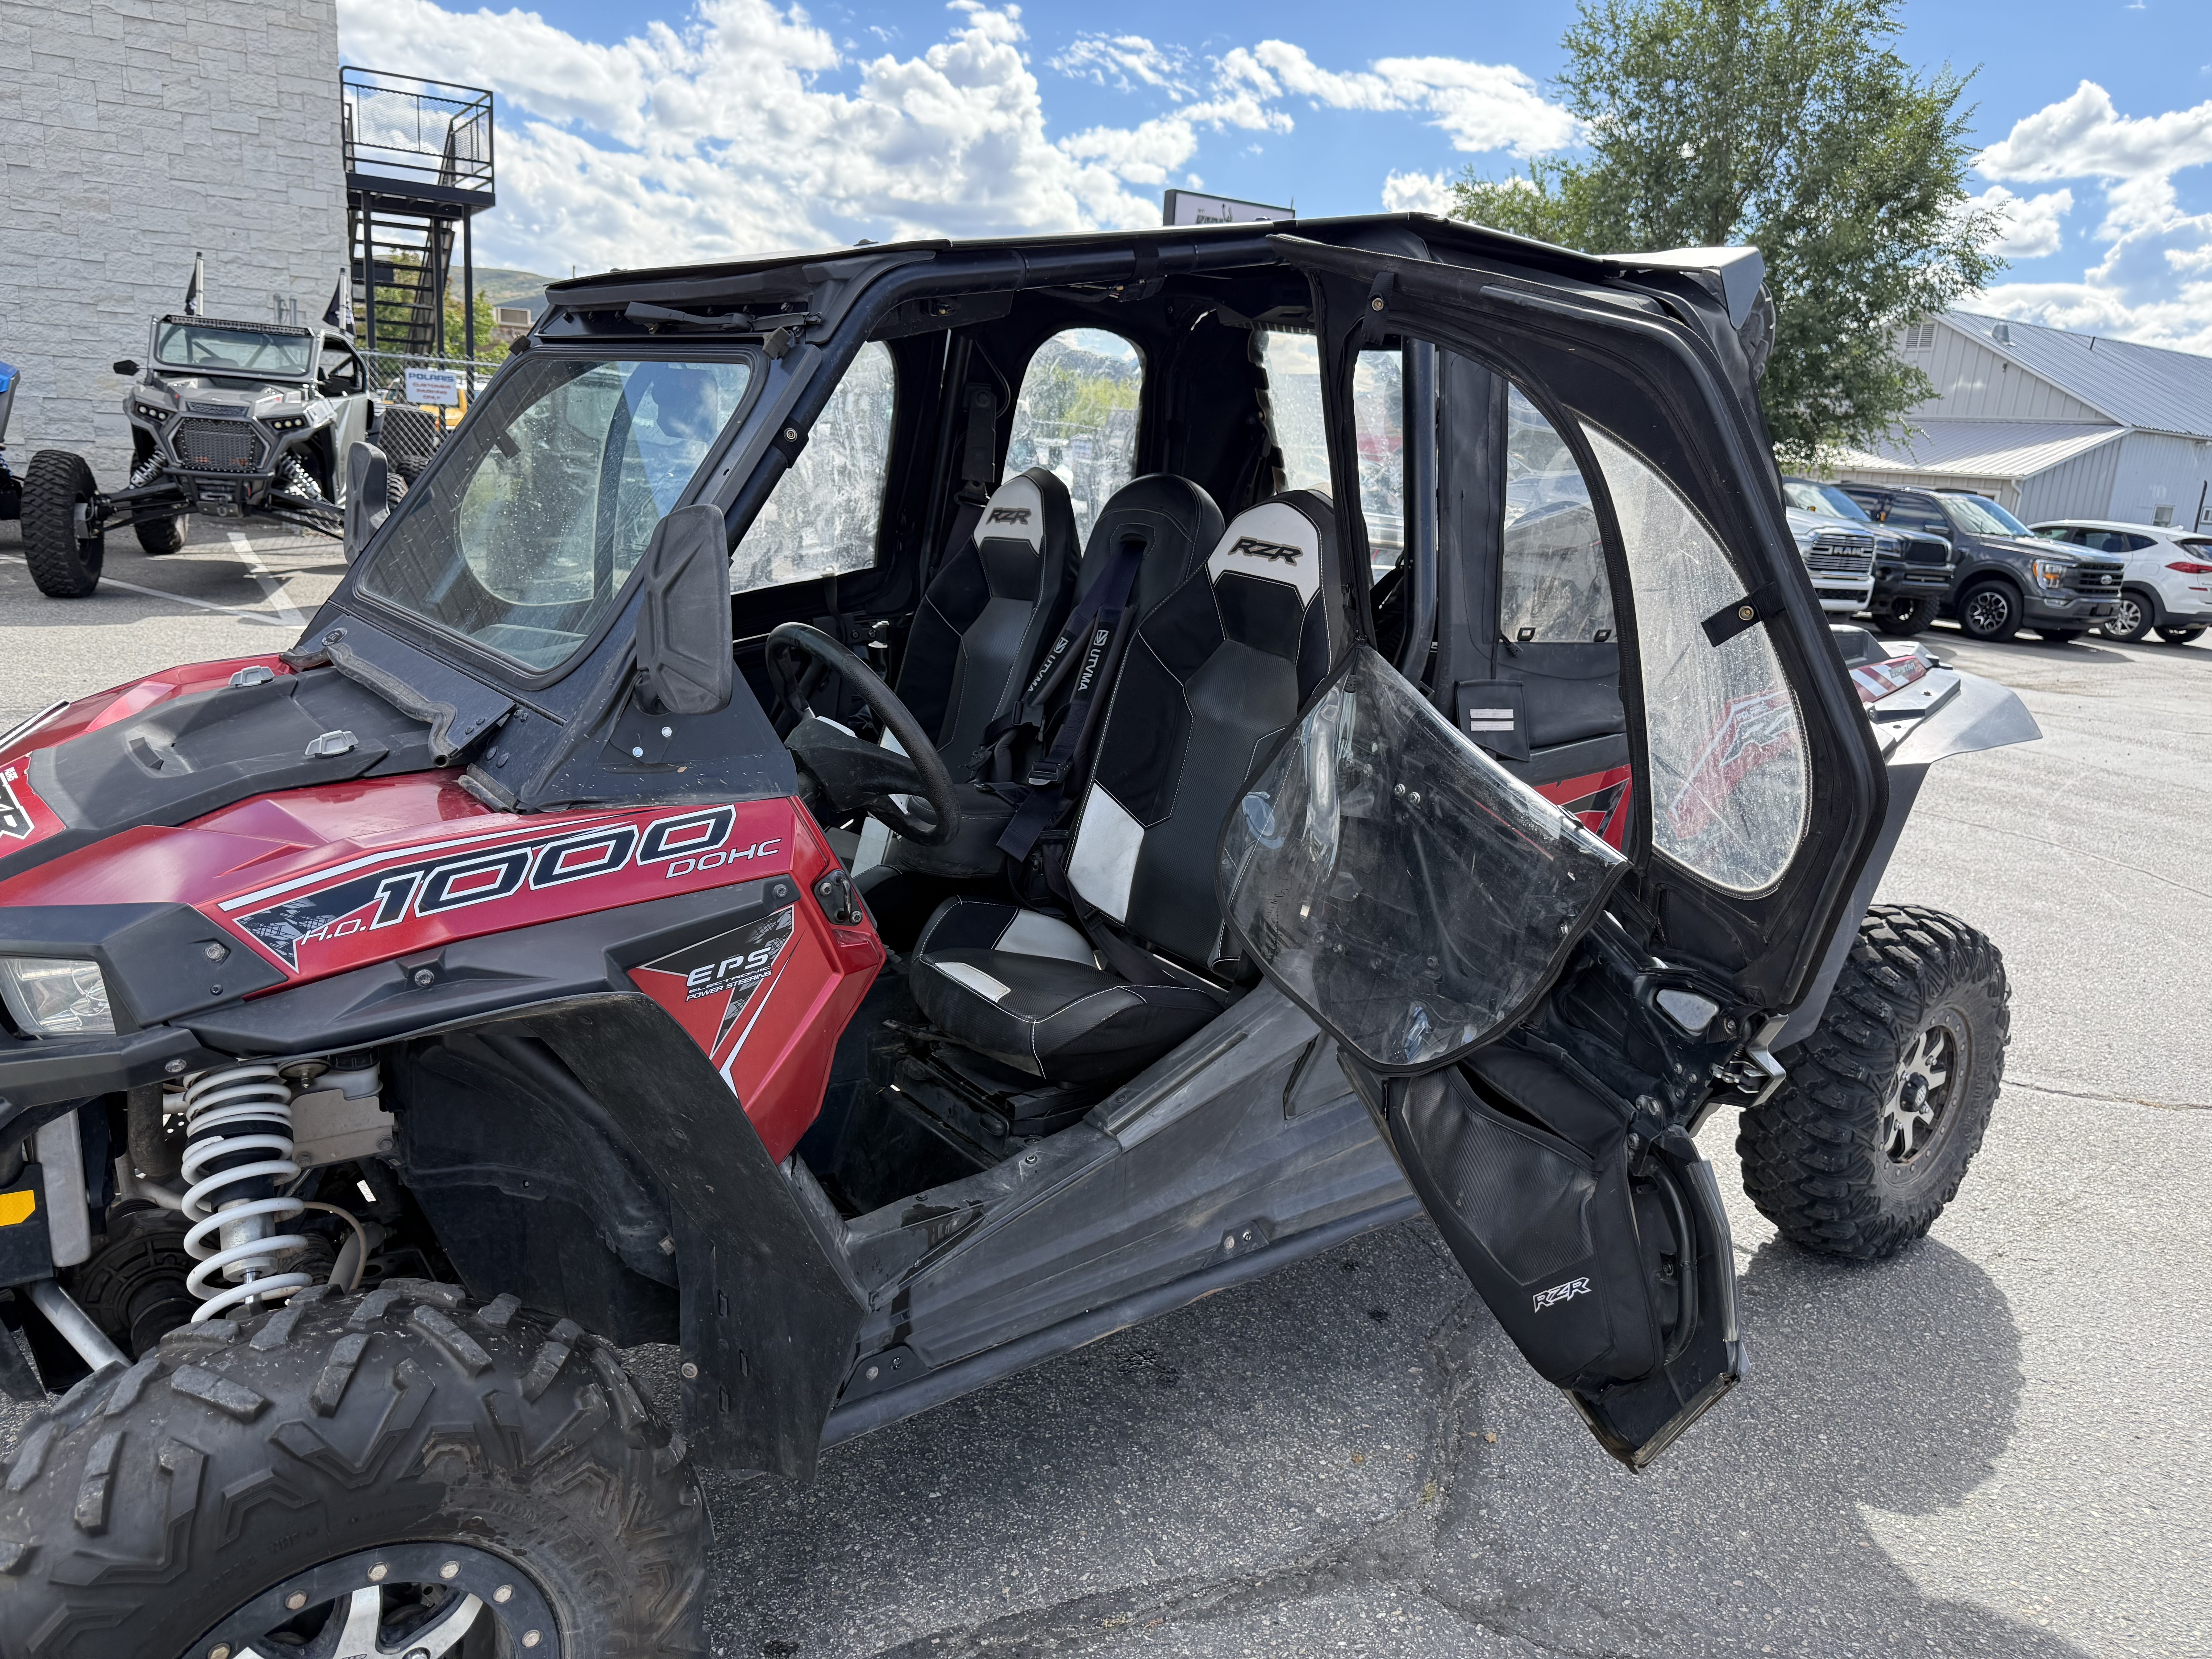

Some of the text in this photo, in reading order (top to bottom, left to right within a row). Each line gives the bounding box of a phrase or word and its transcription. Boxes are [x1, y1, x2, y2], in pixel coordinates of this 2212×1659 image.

[409, 373, 454, 382] POLARIS
[986, 507, 1032, 525] RZR
[1228, 536, 1304, 567] RZR
[1833, 546, 1862, 556] RAM
[1028, 654, 1056, 692] UTVMA
[1078, 649, 1101, 691] UTVMA
[369, 804, 737, 931] 1000
[666, 838, 781, 879] DOHC
[301, 919, 366, 945] H.O.
[687, 946, 771, 987] EPS
[689, 965, 771, 993] ELECTRONIC
[686, 970, 772, 1001] POWER STEERING
[1533, 1277, 1592, 1313] RZR
